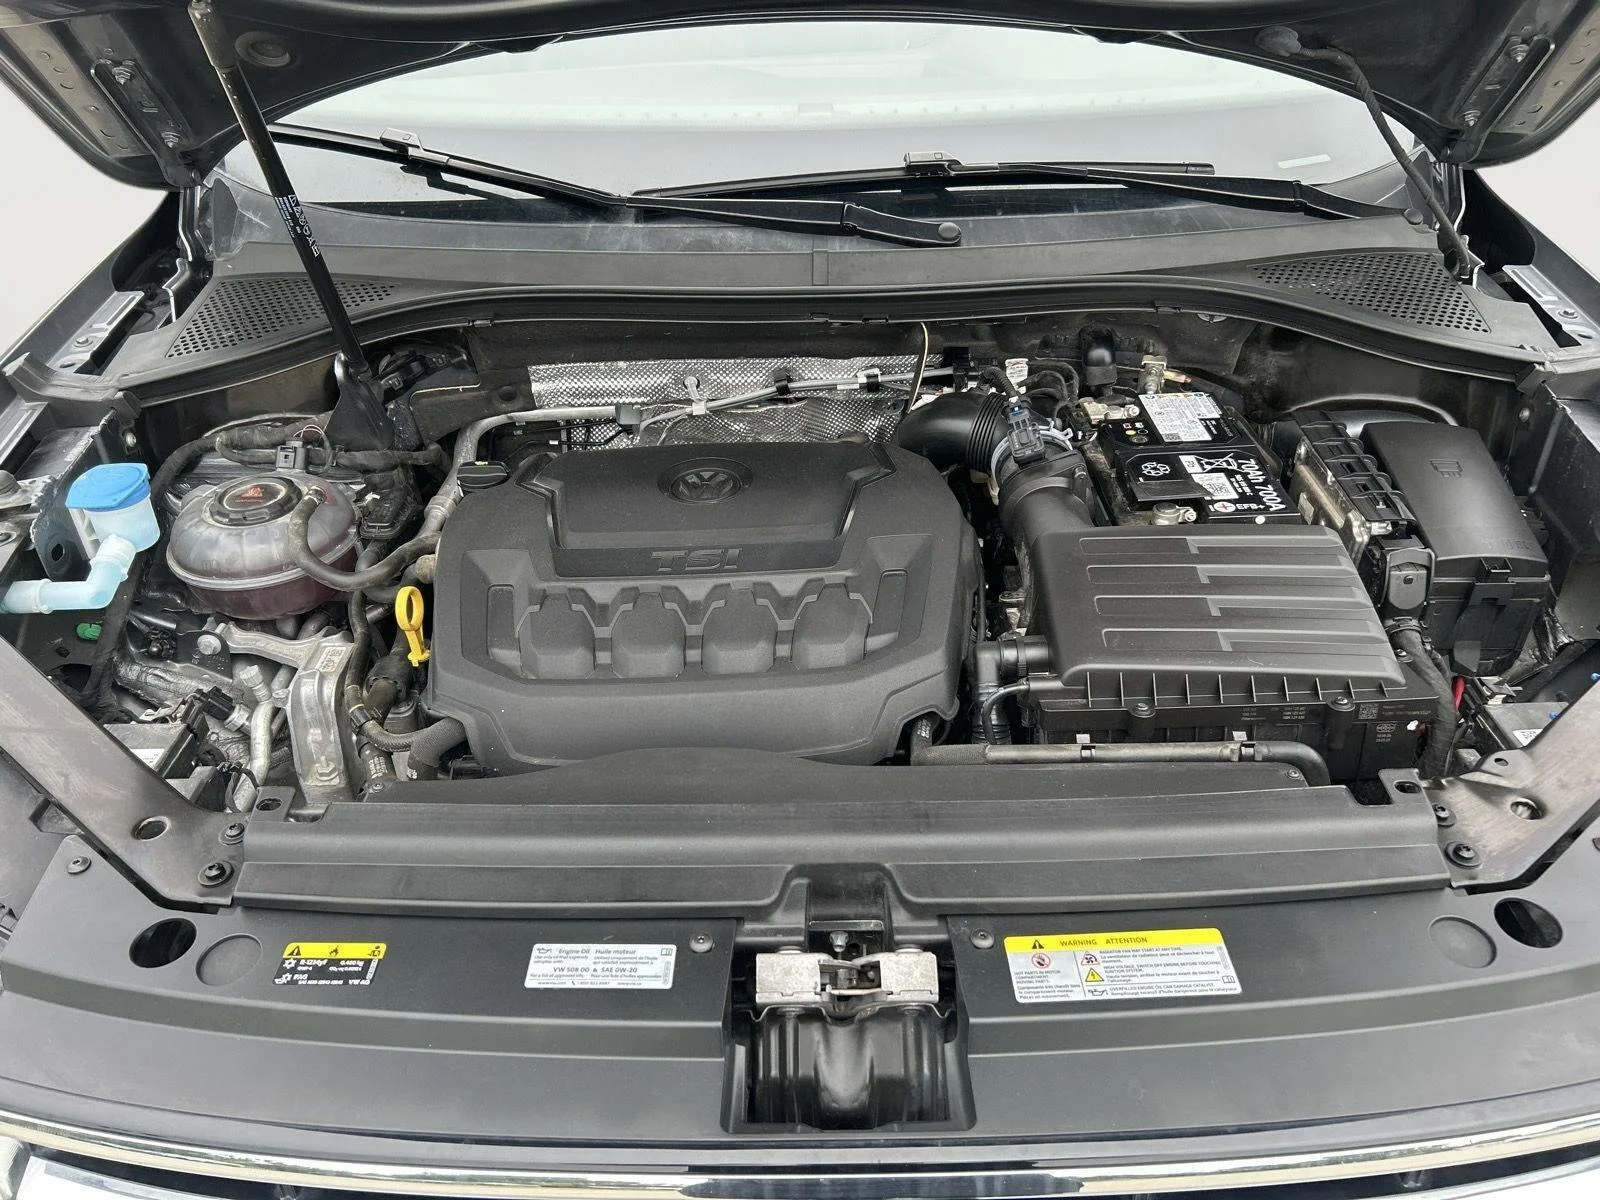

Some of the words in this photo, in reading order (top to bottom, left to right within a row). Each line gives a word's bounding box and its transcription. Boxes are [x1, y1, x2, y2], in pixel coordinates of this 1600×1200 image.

[1238, 459, 1266, 483] 70Ah
[1255, 485, 1286, 511] 700A
[651, 548, 742, 572] TSI
[1105, 936, 1148, 945] ATTENTION
